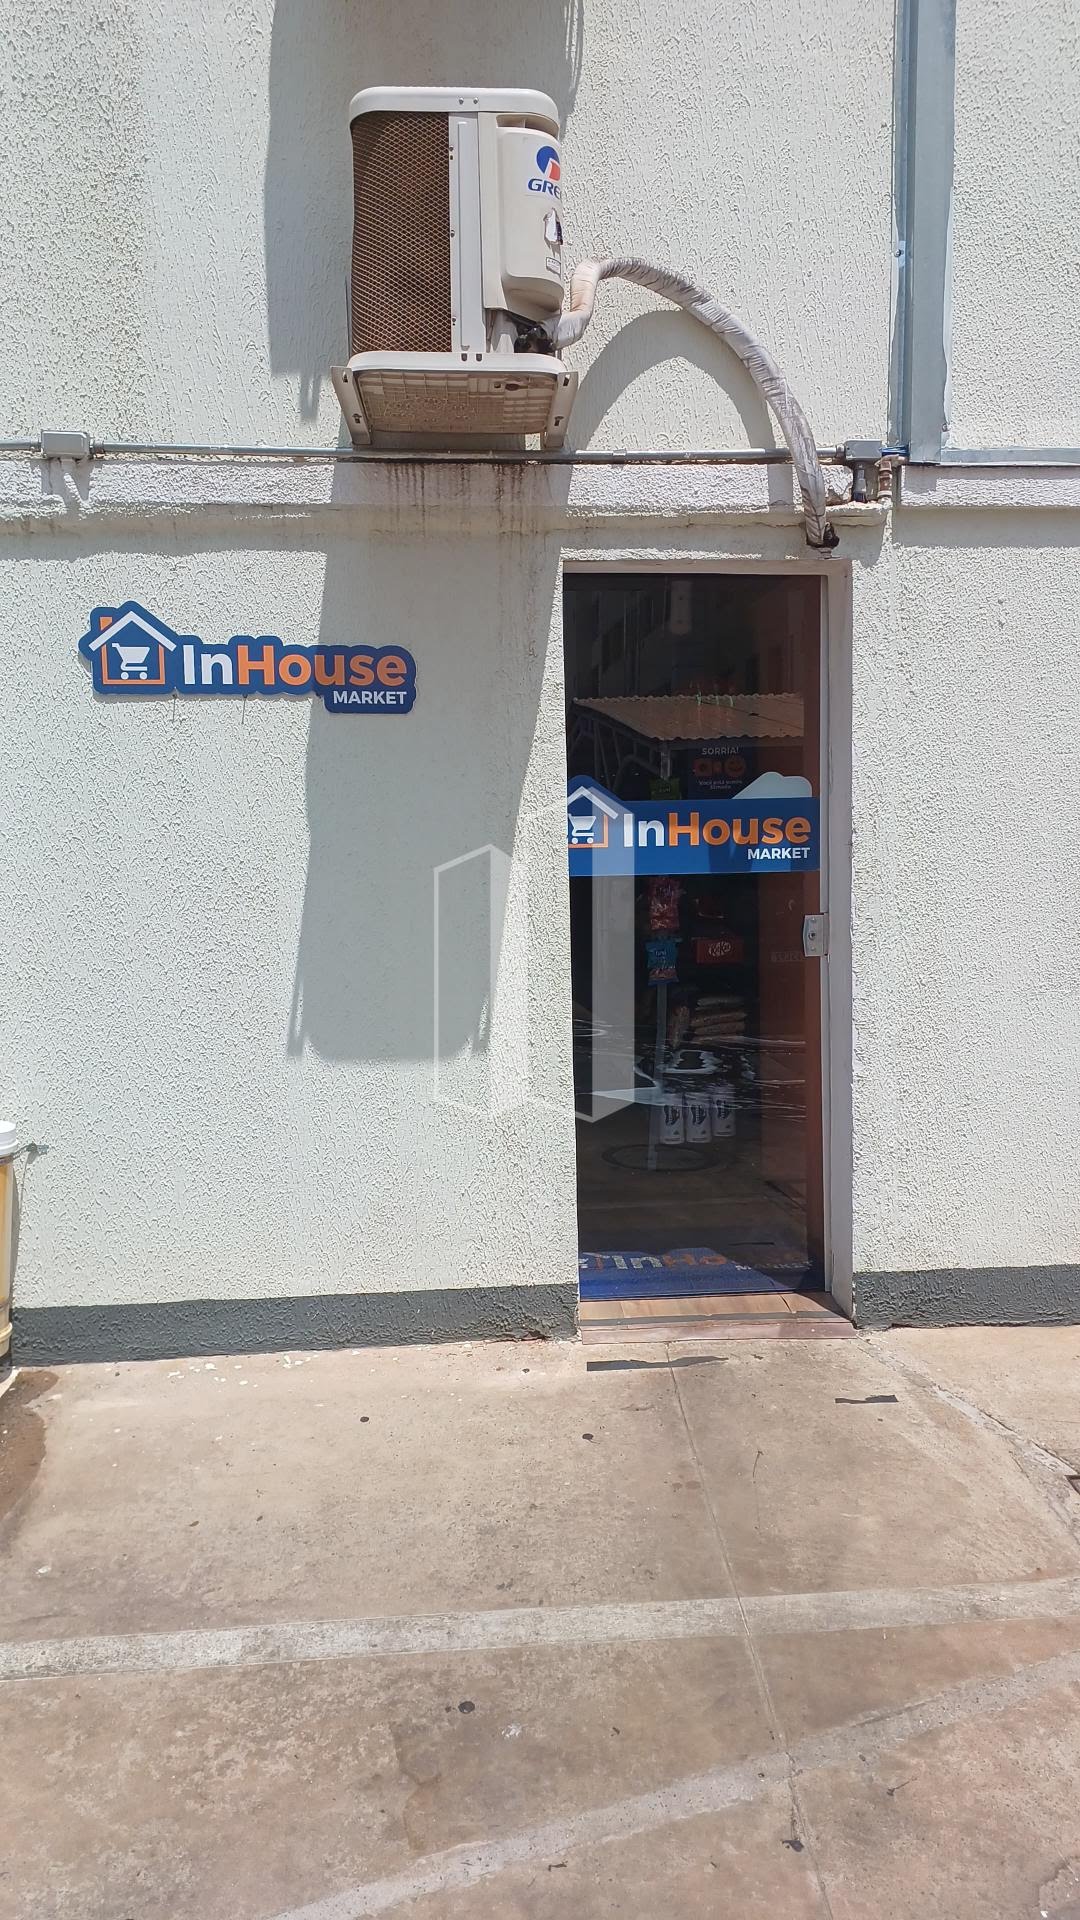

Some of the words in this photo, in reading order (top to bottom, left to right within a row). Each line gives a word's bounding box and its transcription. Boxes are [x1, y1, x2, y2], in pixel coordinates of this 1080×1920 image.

[528, 178, 561, 200] GRE
[183, 644, 407, 686] InHouse
[333, 691, 407, 705] MARKET
[623, 811, 812, 847] InHouse
[747, 847, 811, 860] MARKET
